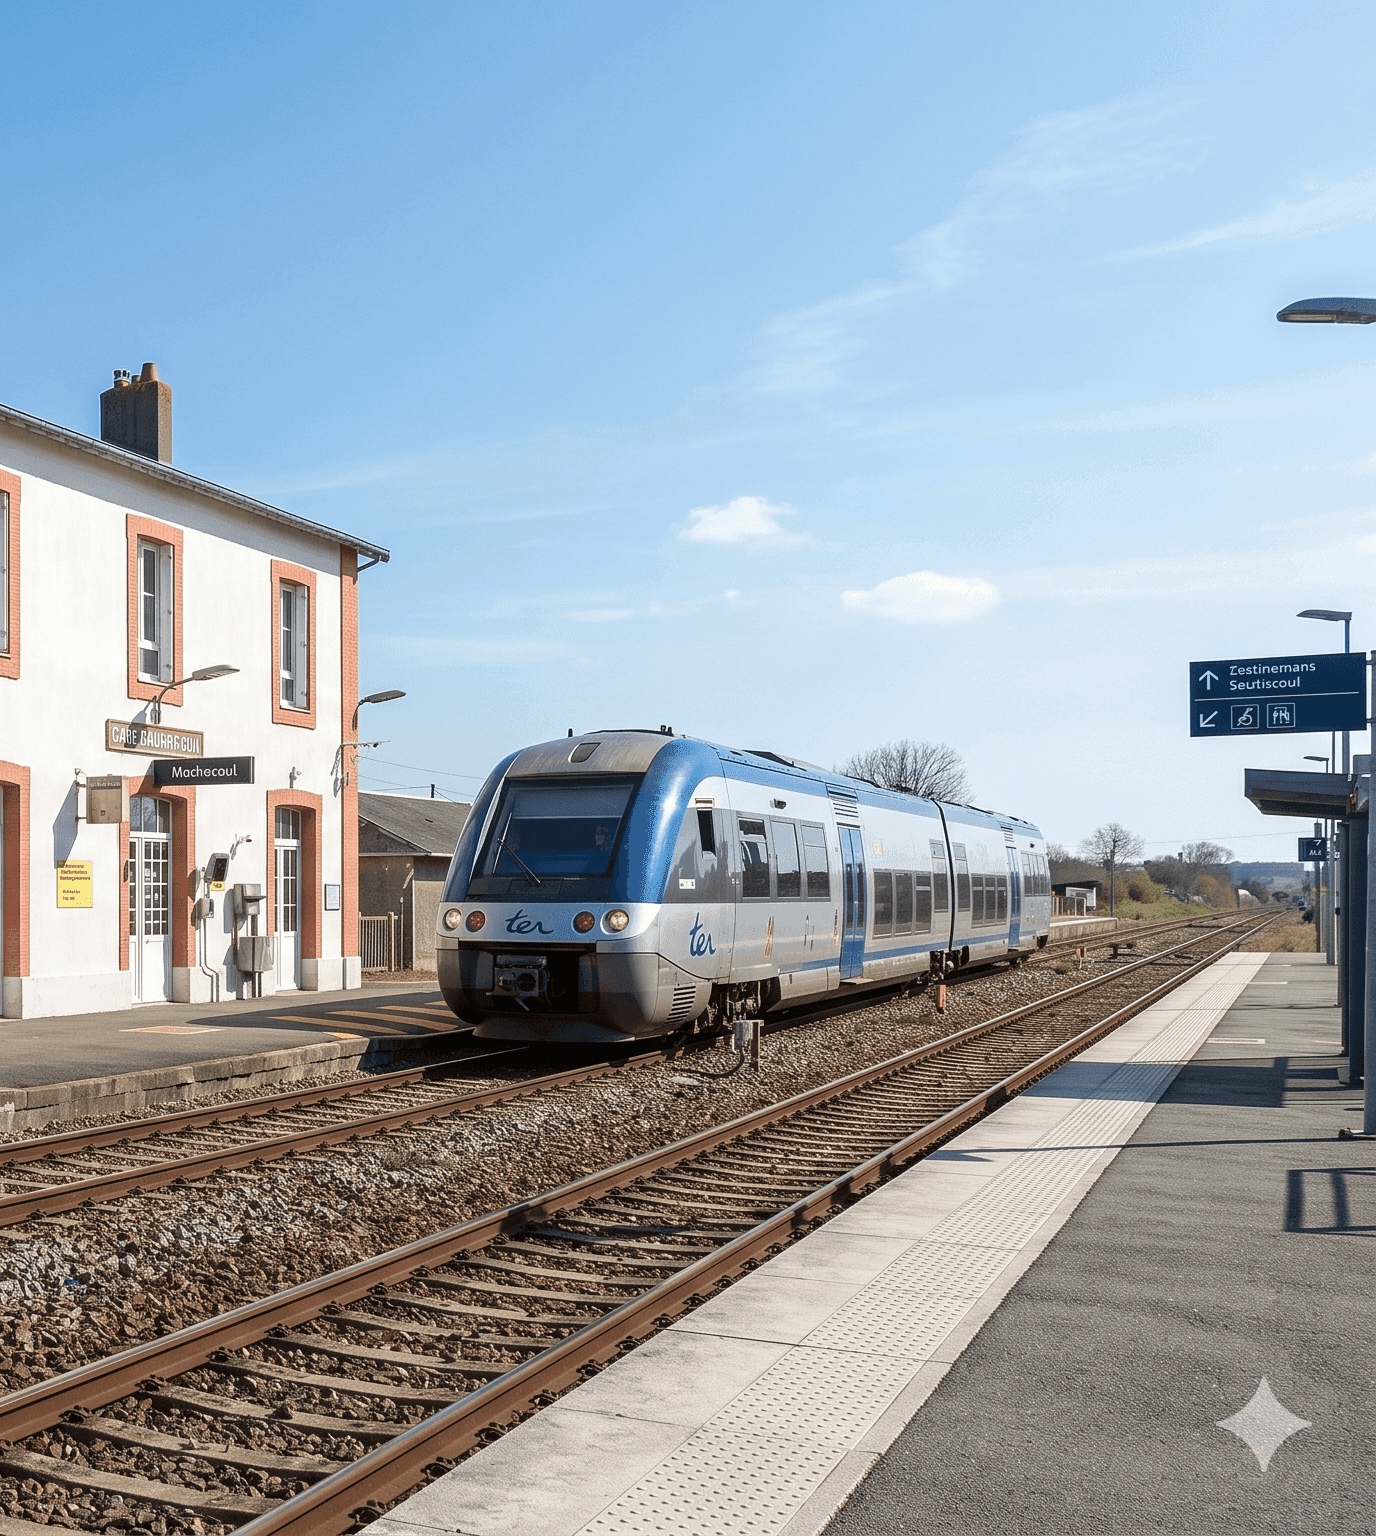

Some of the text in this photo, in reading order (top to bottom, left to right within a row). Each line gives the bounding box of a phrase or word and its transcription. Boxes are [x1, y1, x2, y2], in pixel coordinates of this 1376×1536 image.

[171, 763, 238, 779] Machecoul
[505, 908, 554, 935] ter
[689, 911, 717, 957] ter
